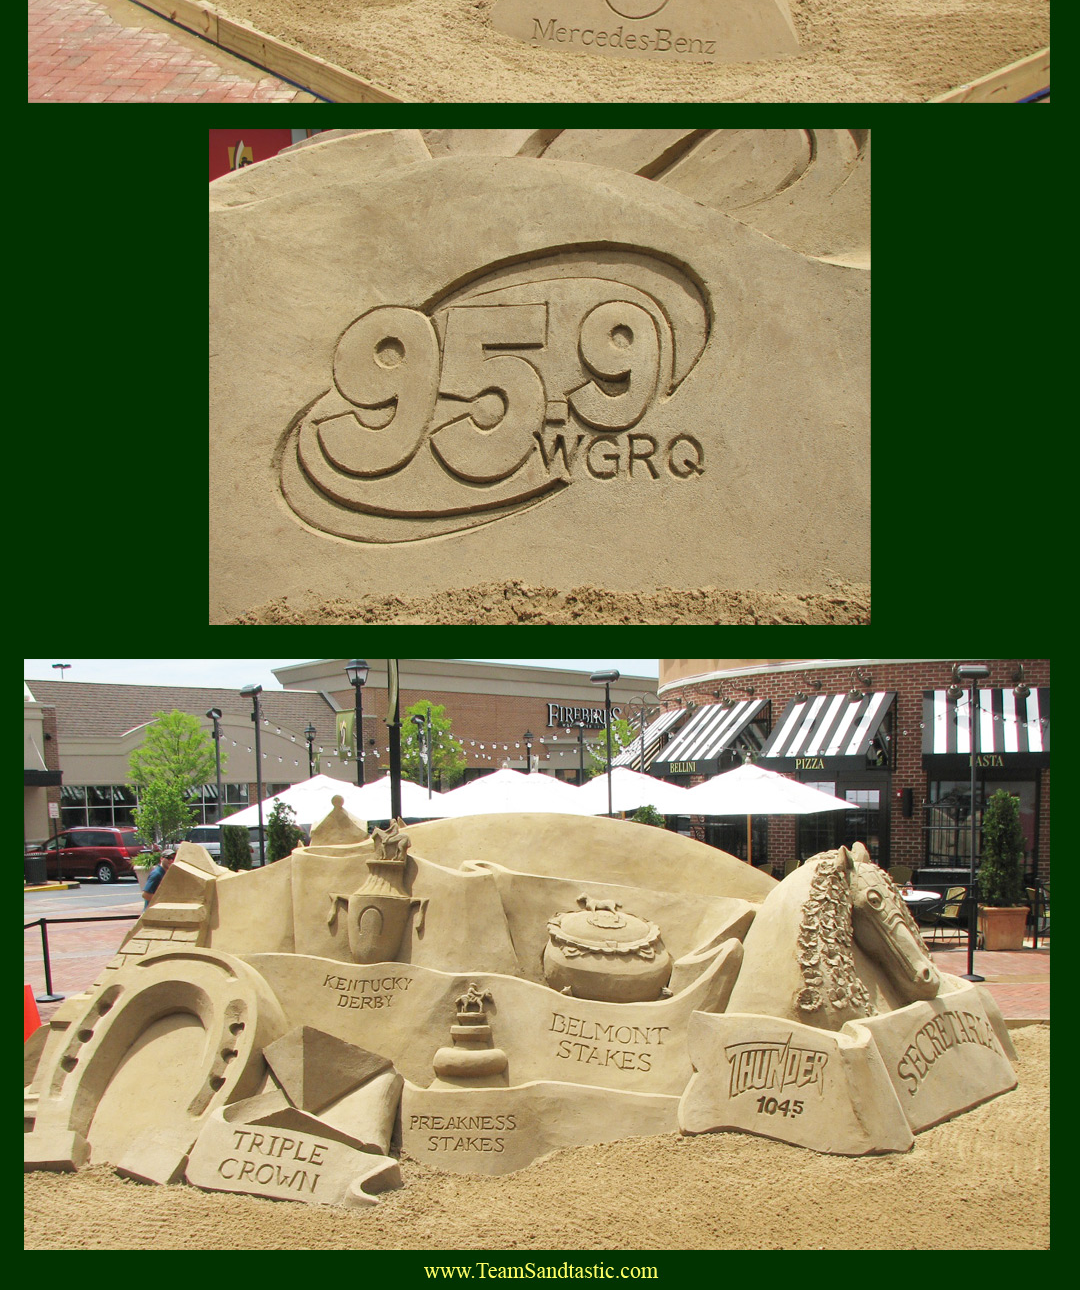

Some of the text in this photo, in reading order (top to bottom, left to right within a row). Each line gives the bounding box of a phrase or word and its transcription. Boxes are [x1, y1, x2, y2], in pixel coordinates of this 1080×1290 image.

[531, 17, 717, 55] Mercedes-Benz
[311, 299, 662, 486] 95.9
[533, 431, 706, 481] WGRQ
[670, 762, 696, 773] BELLINI
[795, 758, 825, 769] PIZZA
[323, 975, 413, 993] KENTUCKY
[337, 994, 394, 1010] DERBY
[549, 1012, 671, 1046] BELMONT
[556, 1040, 652, 1072] STAKES
[724, 1031, 830, 1100] THUNDER
[409, 1115, 518, 1131] PREAKNESS
[233, 1130, 329, 1167] TRIPLE
[427, 1136, 505, 1153] STAKES
[217, 1158, 321, 1194] CROWN
